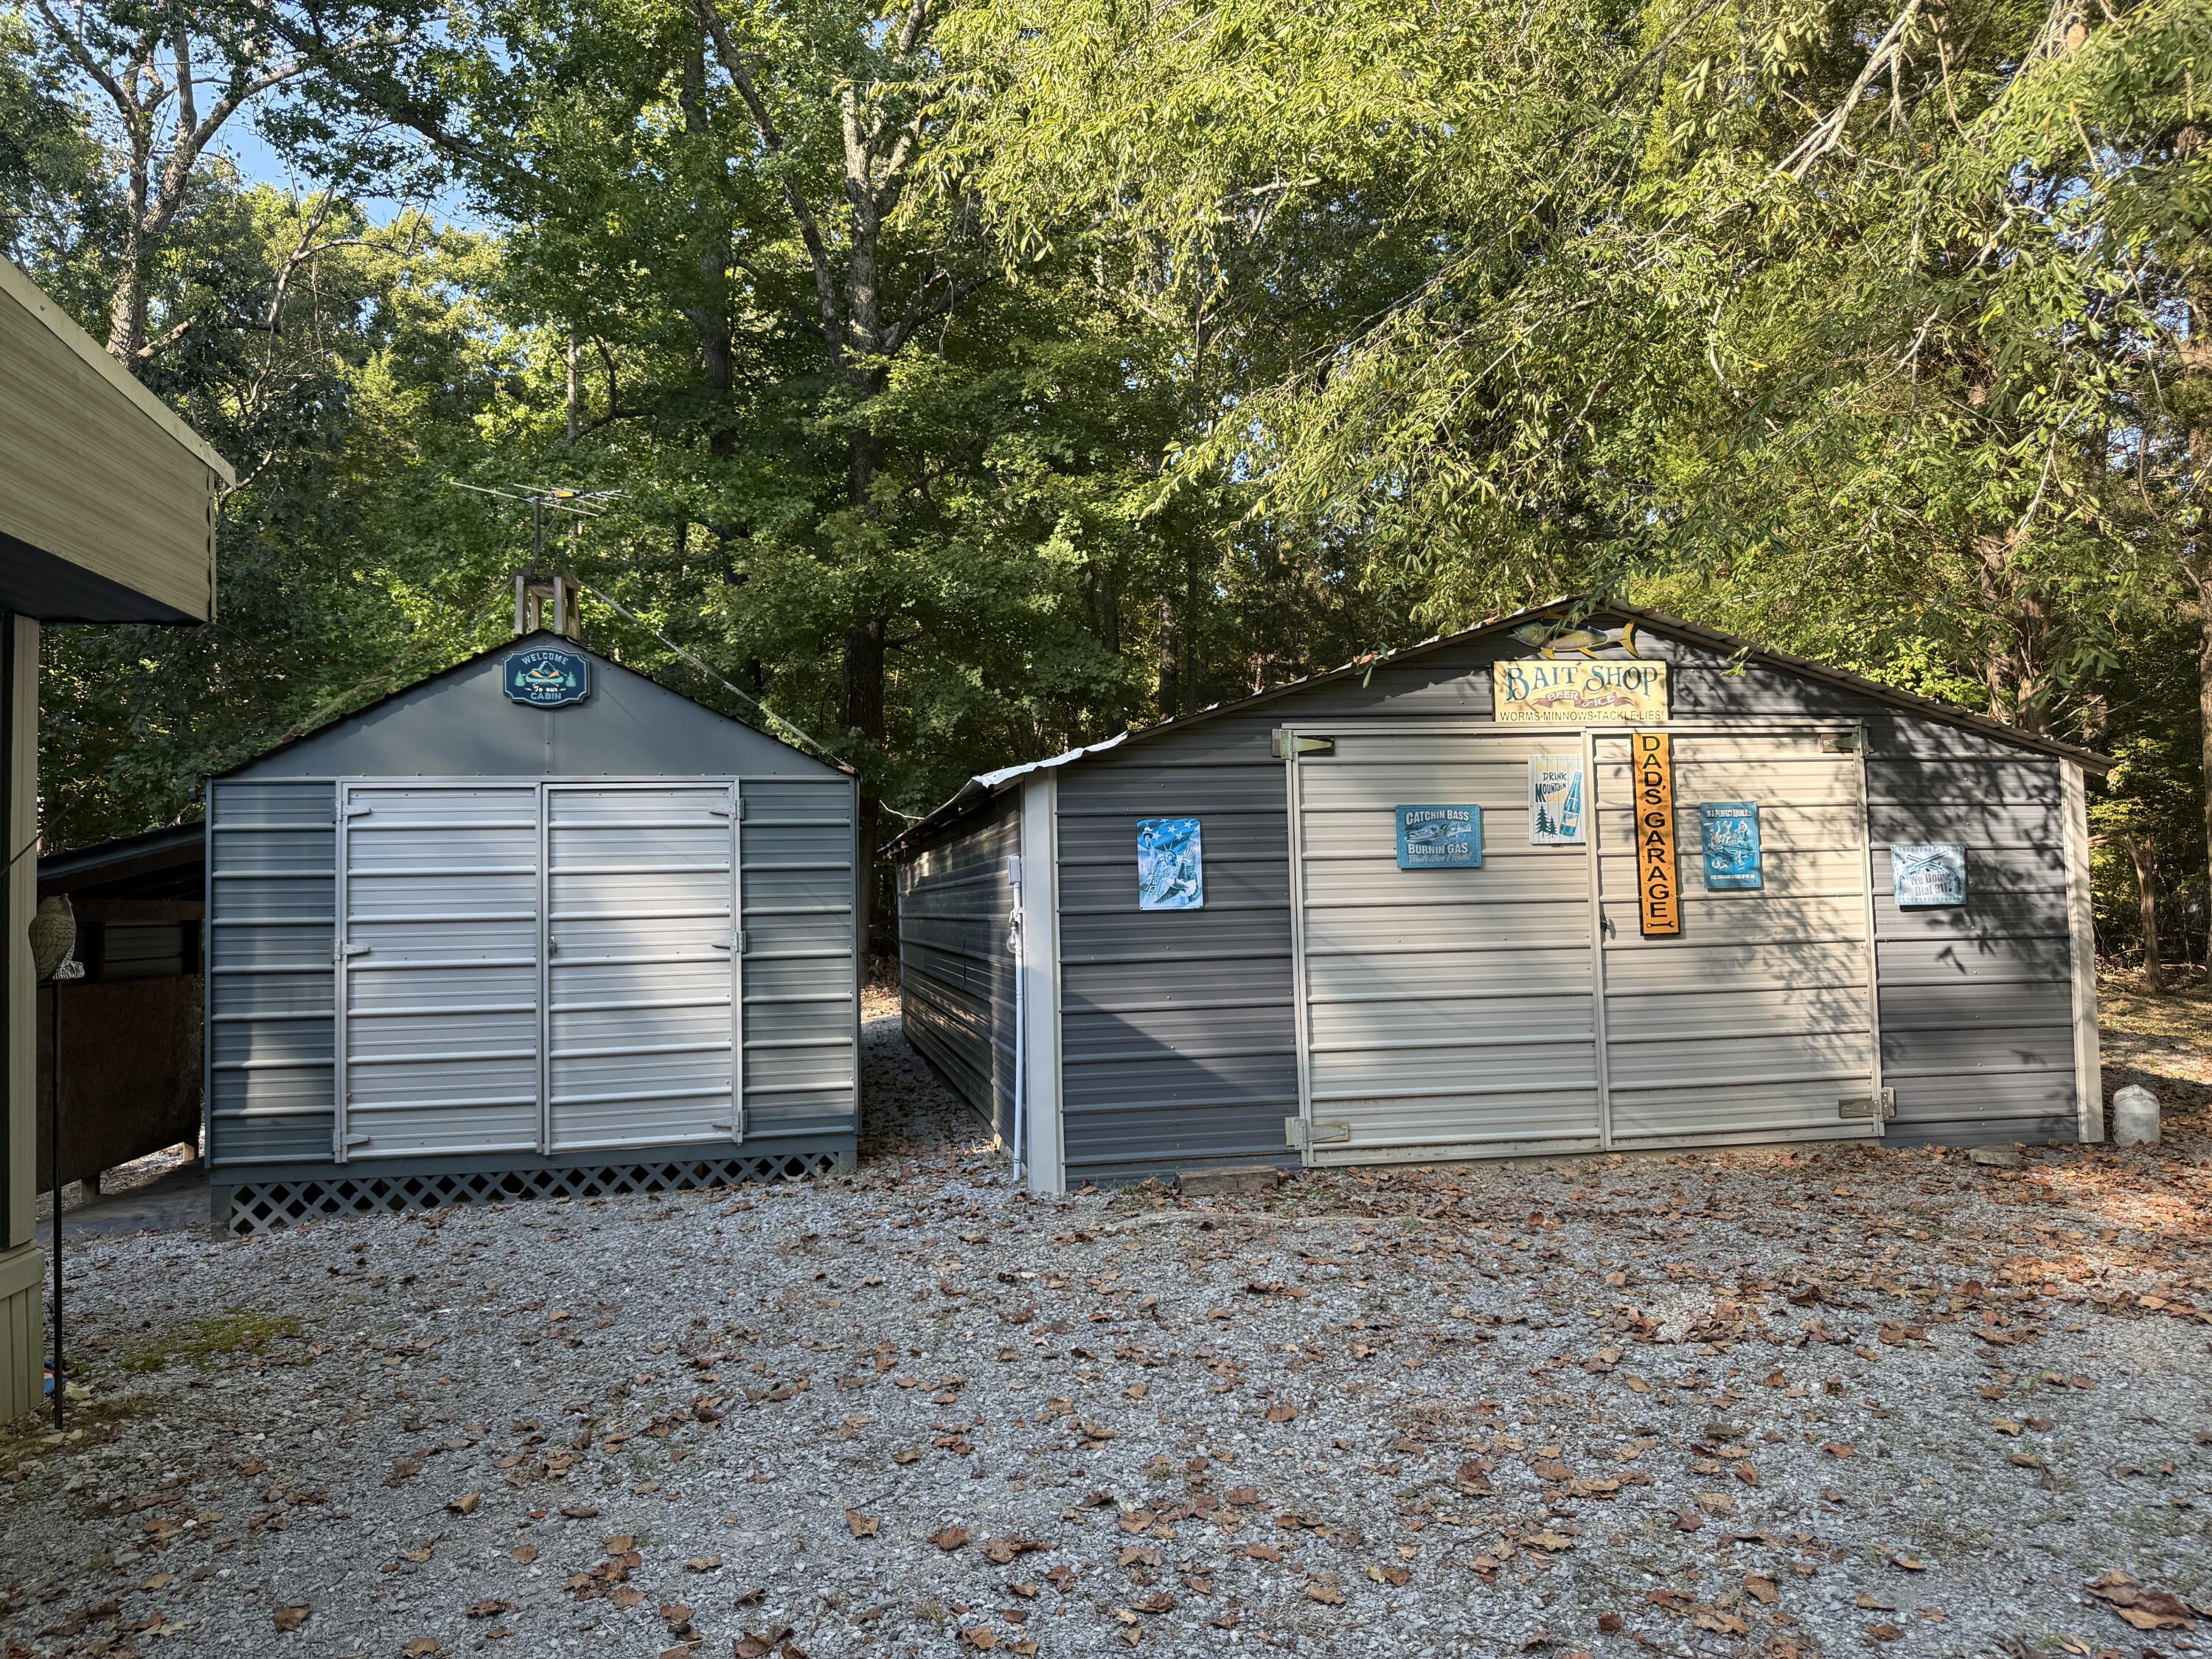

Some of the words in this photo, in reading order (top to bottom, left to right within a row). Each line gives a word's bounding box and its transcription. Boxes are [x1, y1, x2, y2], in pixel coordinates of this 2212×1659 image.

[521, 652, 569, 665] WELCOME
[1506, 667, 1579, 702] BAIT
[1585, 665, 1658, 698] SHOP
[1546, 690, 1579, 702] BEER
[1543, 772, 1567, 781] DRINK
[1641, 735, 1666, 805] DAD'S
[1535, 783, 1566, 803] MOUNTaiN
[1405, 810, 1445, 825] CATCHIN
[1447, 810, 1470, 821] BASS
[1715, 809, 1732, 818] PERFECT
[1408, 843, 1445, 854] BURNIN
[1644, 812, 1669, 919] GARAGE
[1910, 875, 1923, 886] We
[1925, 872, 1949, 883] Don't
[1915, 885, 1933, 896] Dial
[1935, 883, 1948, 894] 911
